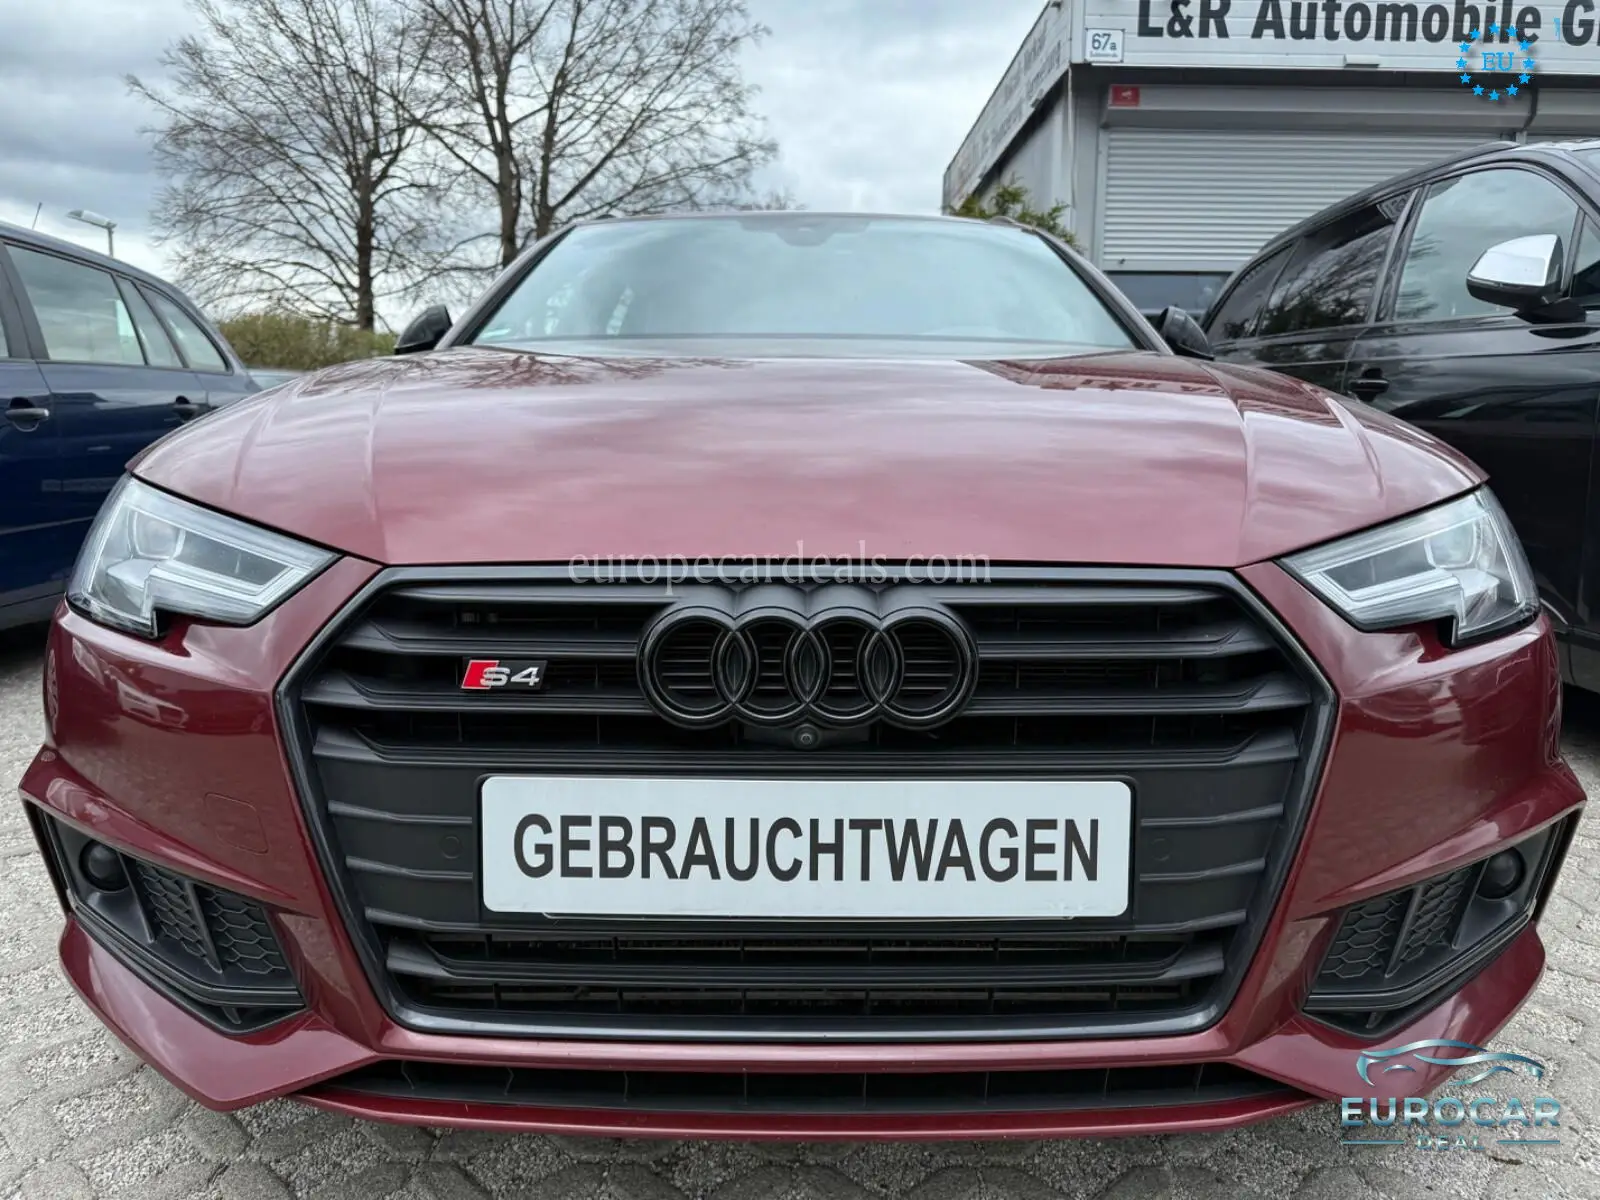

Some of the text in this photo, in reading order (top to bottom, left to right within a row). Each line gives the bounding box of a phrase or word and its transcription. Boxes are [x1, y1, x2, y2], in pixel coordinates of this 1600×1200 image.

[1137, 0, 1600, 47] L&R Automobile G
[1091, 33, 1118, 51] 67a
[480, 667, 541, 687] S4
[513, 813, 1101, 883] GEBRAUCHTWAGEN
